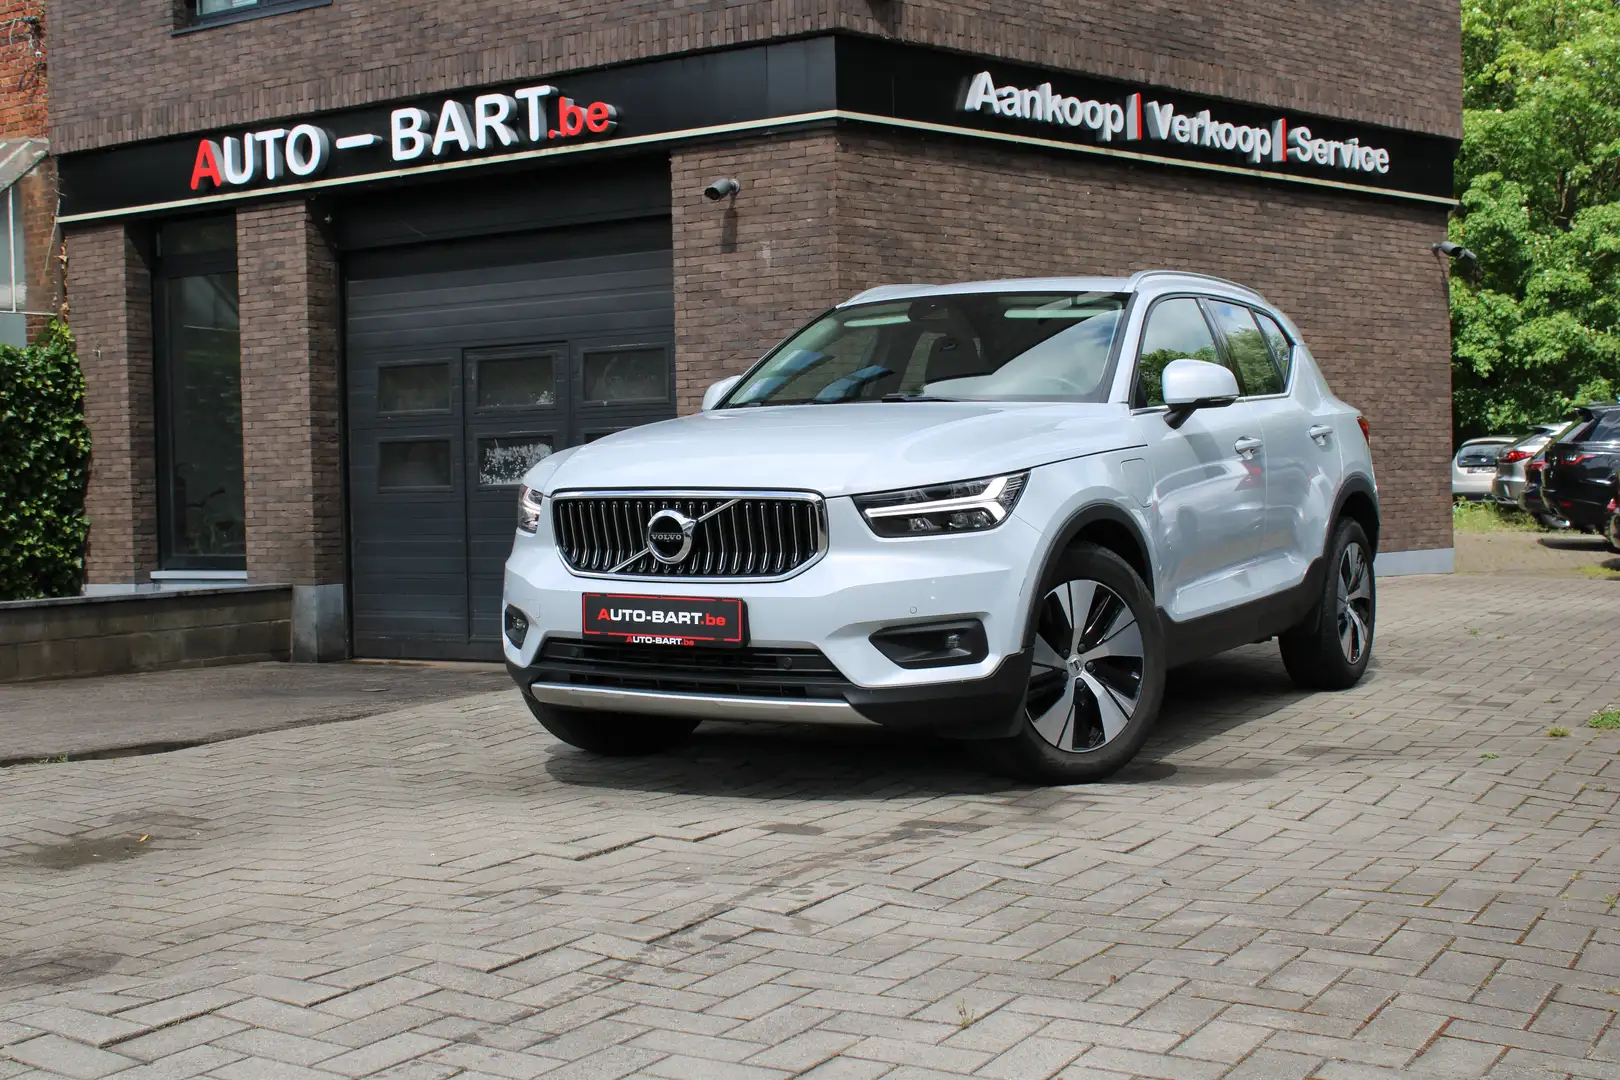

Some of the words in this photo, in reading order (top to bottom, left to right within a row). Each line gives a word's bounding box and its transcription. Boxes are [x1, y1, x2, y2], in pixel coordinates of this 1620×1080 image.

[965, 71, 1125, 142] Aankoop
[1146, 100, 1272, 163] Verkoop
[1287, 126, 1390, 174] Service
[597, 607, 726, 626] AUTO-BART.be
[626, 635, 695, 647] AUTO-BART.be
